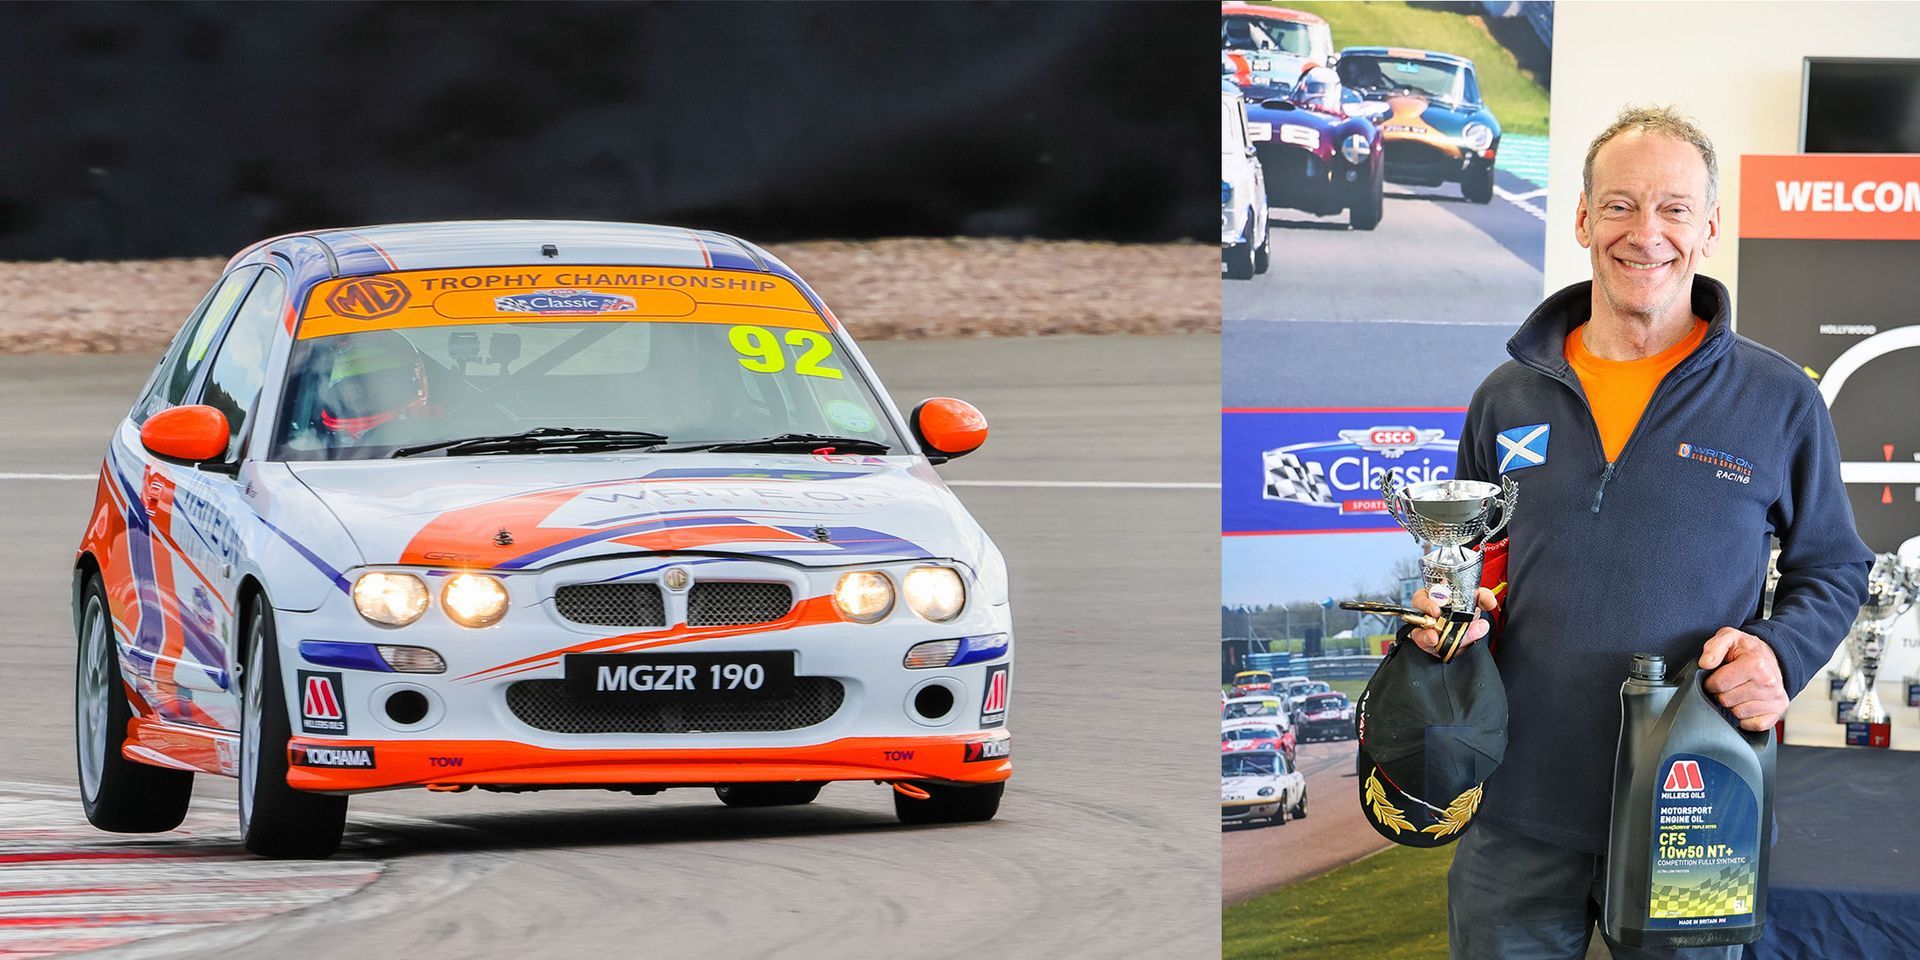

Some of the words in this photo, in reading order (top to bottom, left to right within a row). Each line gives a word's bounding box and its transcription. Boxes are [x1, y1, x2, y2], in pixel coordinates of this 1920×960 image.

[421, 273, 543, 291] TROPHY
[555, 273, 777, 293] CHAMPIONSHIP
[337, 280, 400, 315] MG
[530, 297, 600, 309] Classic
[728, 324, 843, 380] 92
[1374, 431, 1412, 444] CSCC
[1693, 445, 1735, 463] WRITE
[1735, 457, 1754, 470] ON
[1329, 456, 1449, 491] Classic
[1716, 470, 1751, 484] RACING
[596, 664, 697, 692] MGZR
[710, 663, 765, 690] 190
[306, 747, 372, 766] YOKOHAMA
[428, 756, 464, 768] TOW
[883, 750, 915, 761] TOW
[1661, 792, 1689, 800] MILLERS
[1660, 806, 1713, 815] MOTORSPORT
[1659, 815, 1690, 824] ENGINE
[1690, 815, 1704, 823] OIL
[1659, 832, 1687, 846] CFS
[1659, 845, 1704, 860] 10w50
[1707, 844, 1734, 859] NT+
[1657, 859, 1697, 867] COMPETITION
[1716, 857, 1746, 865] SYNTHETIC
